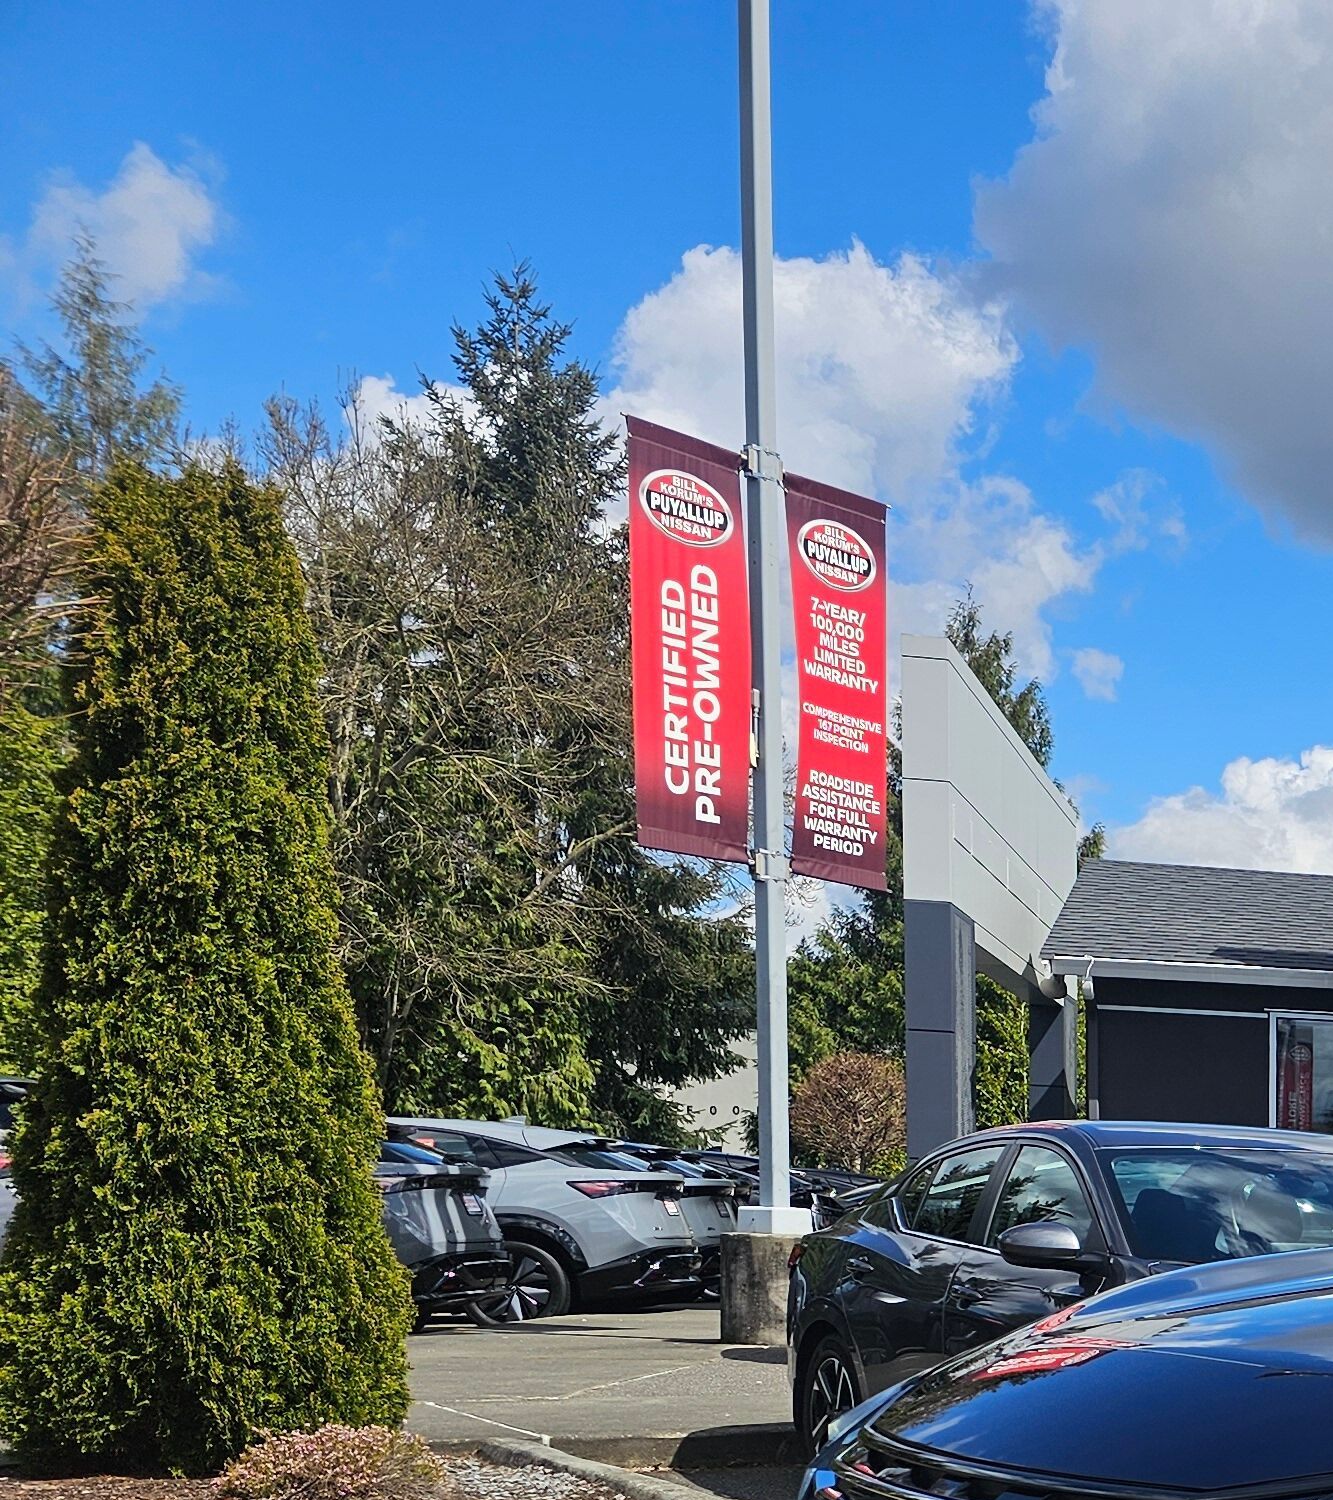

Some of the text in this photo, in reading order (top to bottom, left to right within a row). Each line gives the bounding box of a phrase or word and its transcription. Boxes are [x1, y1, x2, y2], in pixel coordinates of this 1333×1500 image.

[660, 482, 713, 508] KORUM'S
[672, 475, 698, 492] BILL
[650, 491, 725, 529] PUYALLUP
[661, 514, 711, 539] NISSAN
[824, 525, 847, 541] BILL
[807, 539, 869, 575] PUYALLUP
[813, 531, 860, 555] KORUM'S
[815, 561, 857, 584] NISSAN
[810, 596, 866, 628] 7-YEAR/
[809, 612, 864, 643] 100,000
[820, 631, 859, 657] MILES
[813, 646, 866, 675] LIMITED
[661, 579, 688, 795] CERTIFIED
[803, 659, 879, 694] WARRANTY
[691, 564, 720, 824] PRE-OWNED
[802, 702, 882, 734] COMPREHENSIVE
[833, 723, 864, 740] POINT
[813, 728, 869, 753] INSPECTION
[809, 769, 874, 798] ROADSIDE
[802, 784, 881, 815] ASSISTANCE
[809, 800, 870, 828] FOR FULL
[803, 815, 878, 844] WARRANTY
[813, 833, 864, 856] PERIOD
